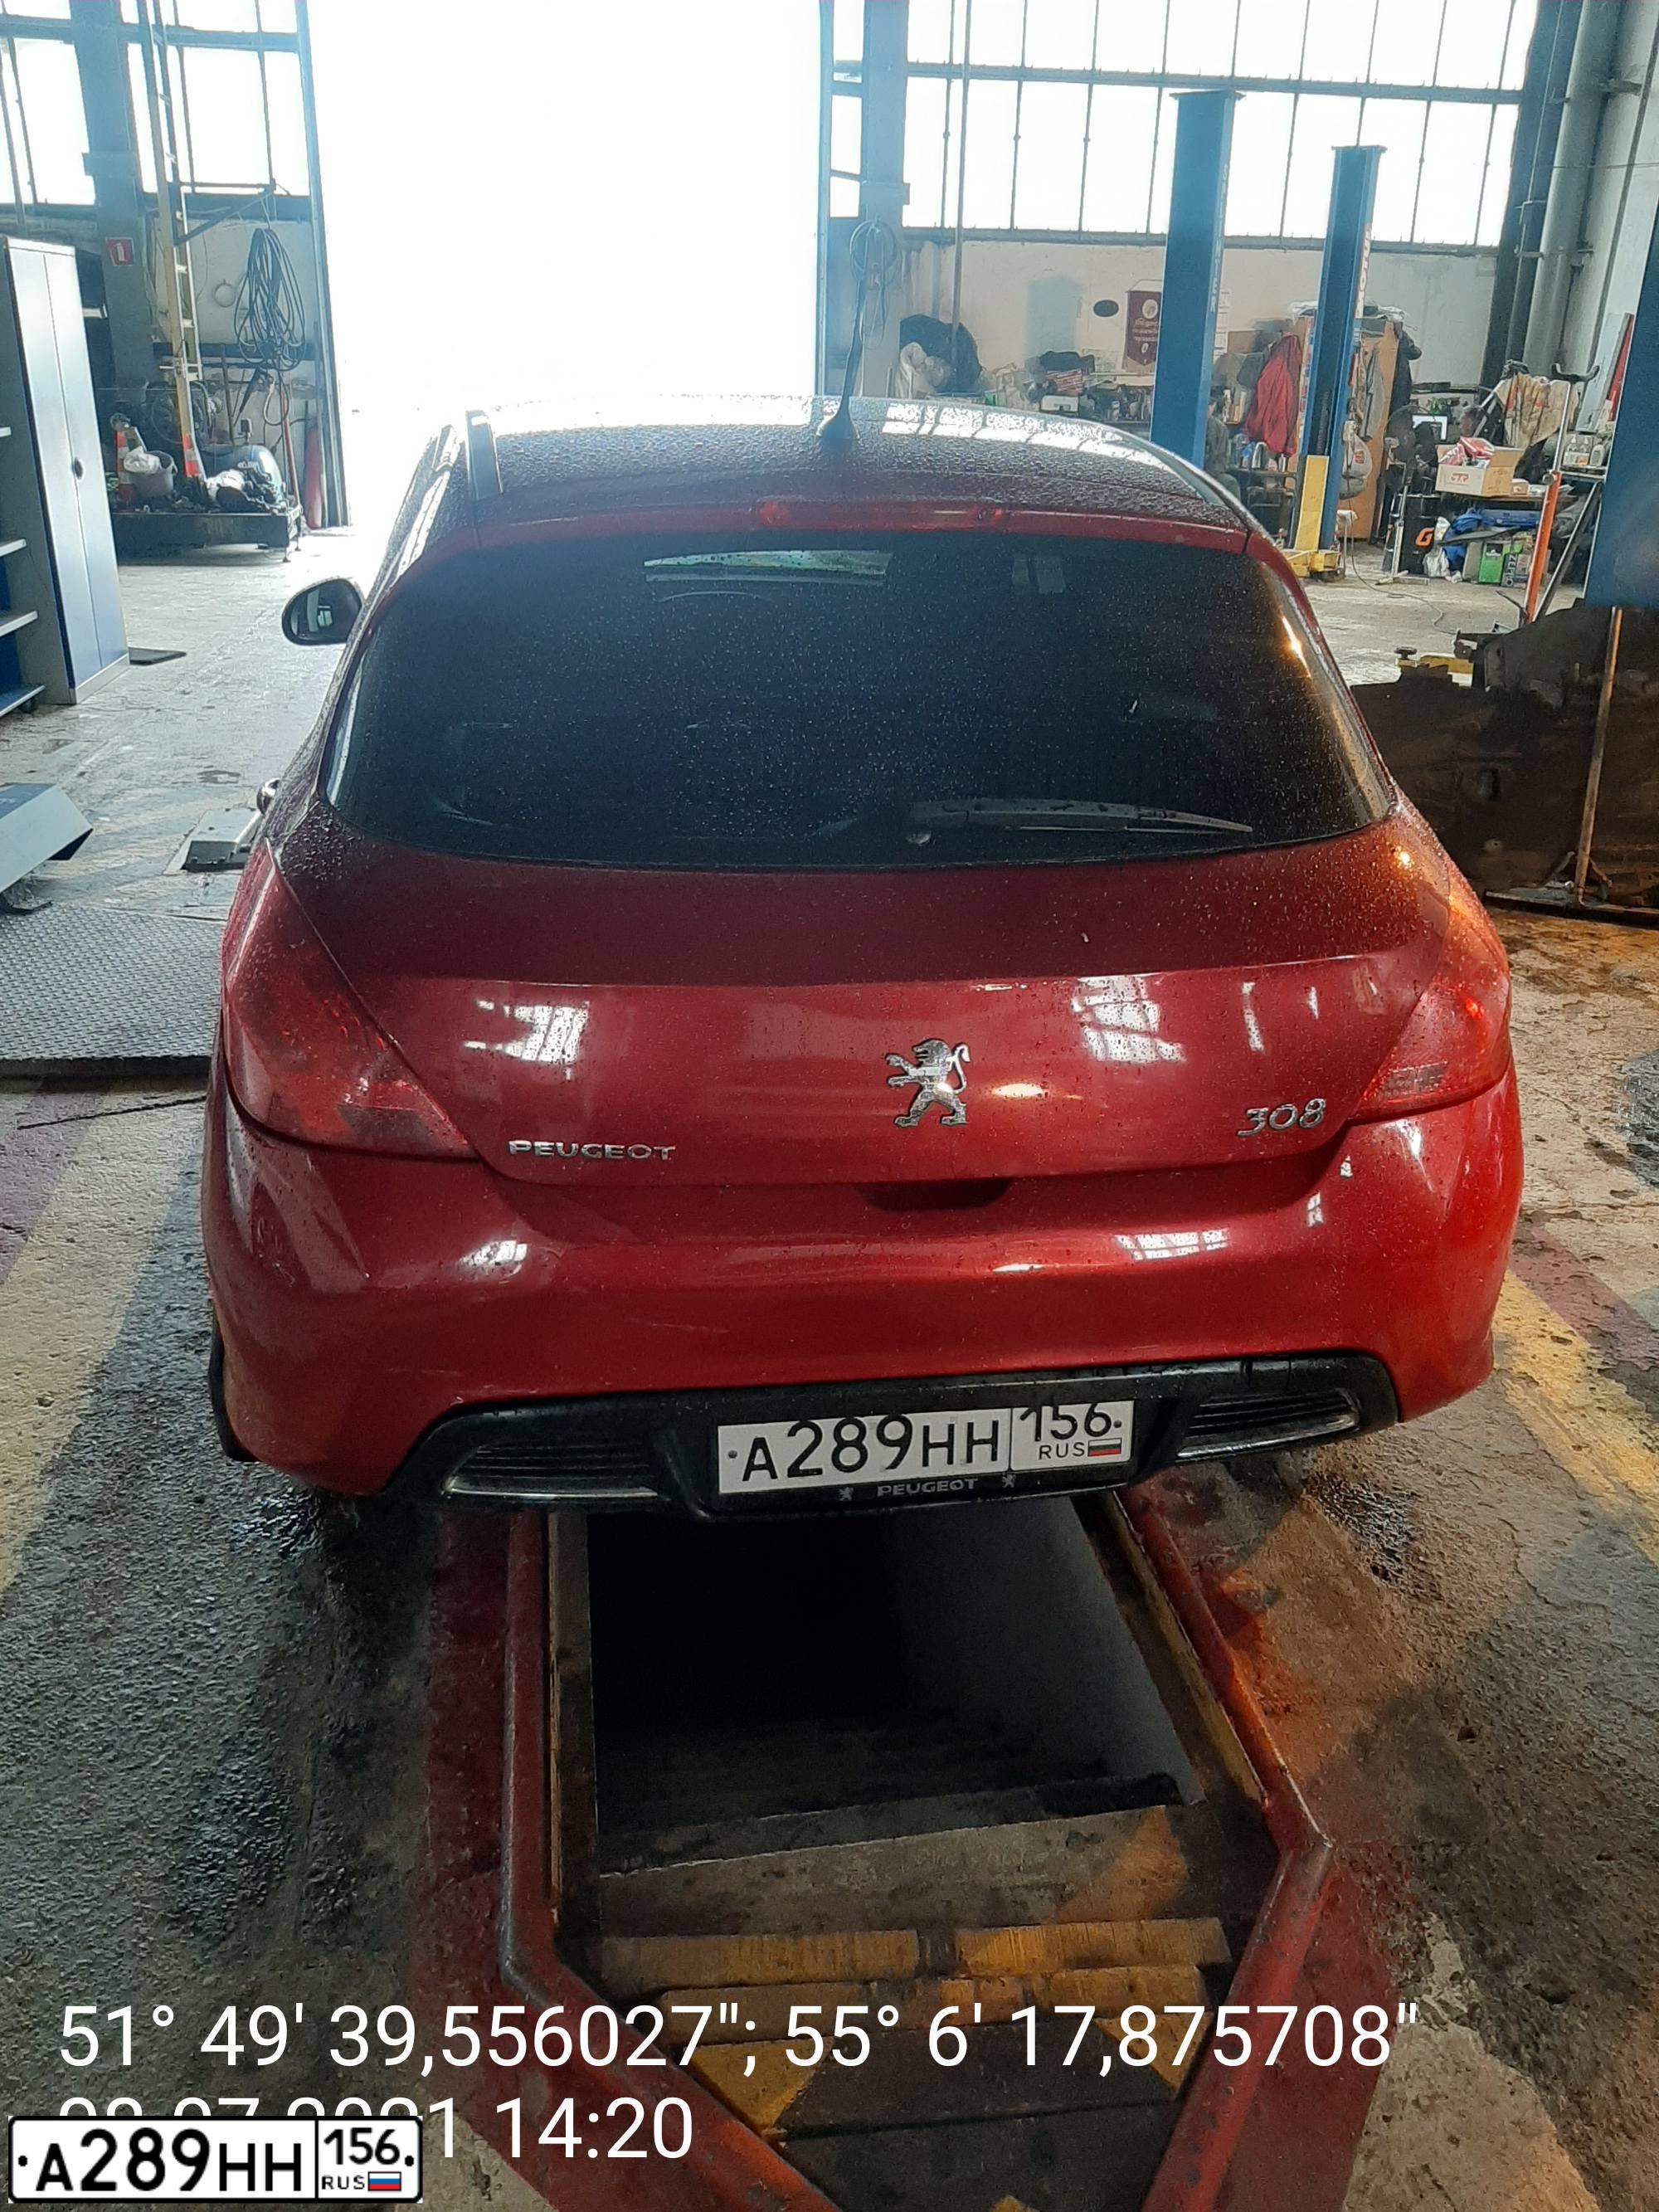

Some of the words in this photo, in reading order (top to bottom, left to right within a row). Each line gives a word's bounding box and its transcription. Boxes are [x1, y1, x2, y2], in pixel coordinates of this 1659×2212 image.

[1237, 1098, 1326, 1137] 308
[508, 1139, 677, 1161] PEUGEOT
[1019, 1405, 1112, 1442] 156
[1039, 1442, 1086, 1460] RUS
[877, 1479, 980, 1497] PEUGEOT
